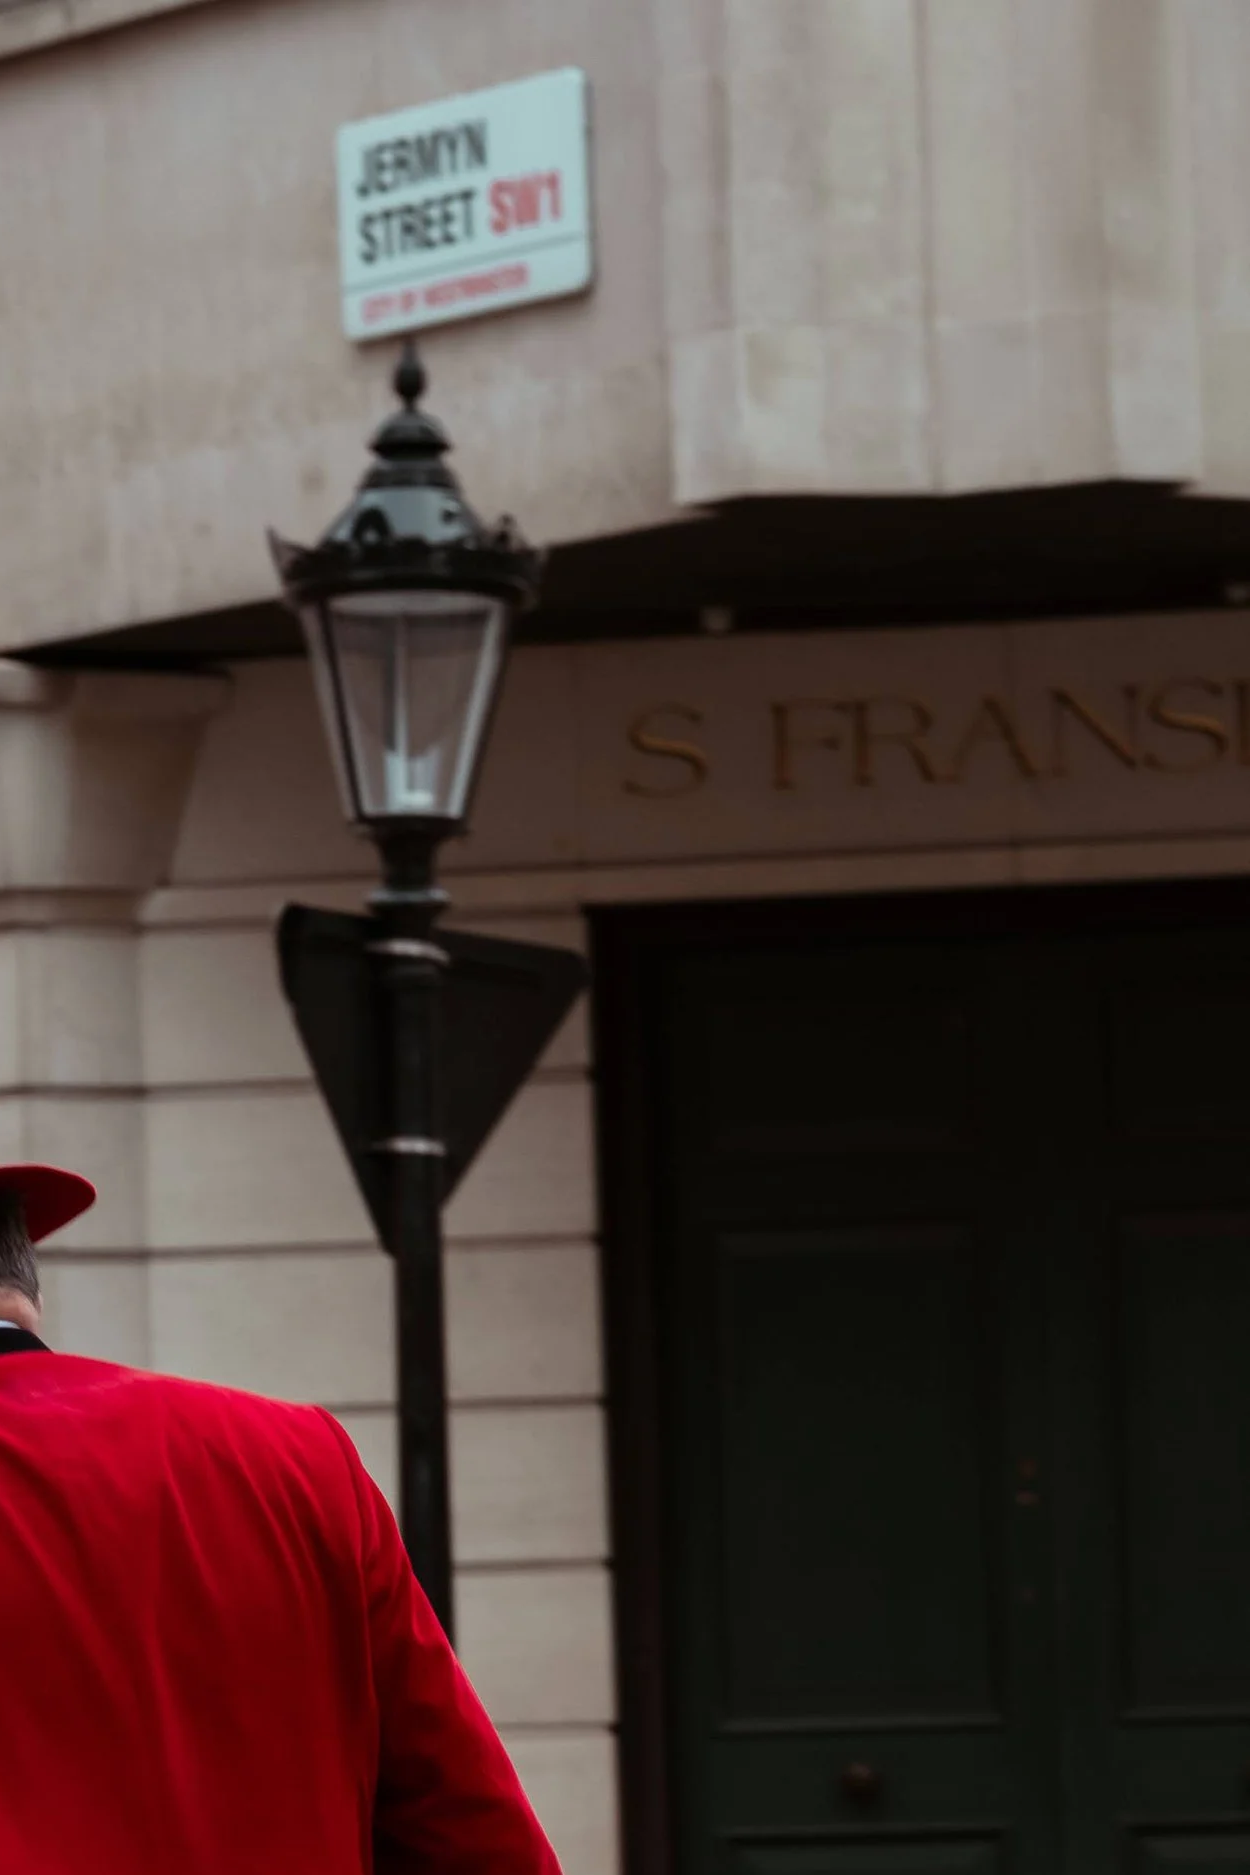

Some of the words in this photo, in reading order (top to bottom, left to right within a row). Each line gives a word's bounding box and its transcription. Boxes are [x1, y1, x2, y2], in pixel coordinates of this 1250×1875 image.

[356, 118, 488, 198] JERMYN
[359, 187, 477, 266] STREET
[489, 169, 563, 237] SW1
[623, 700, 708, 798] S
